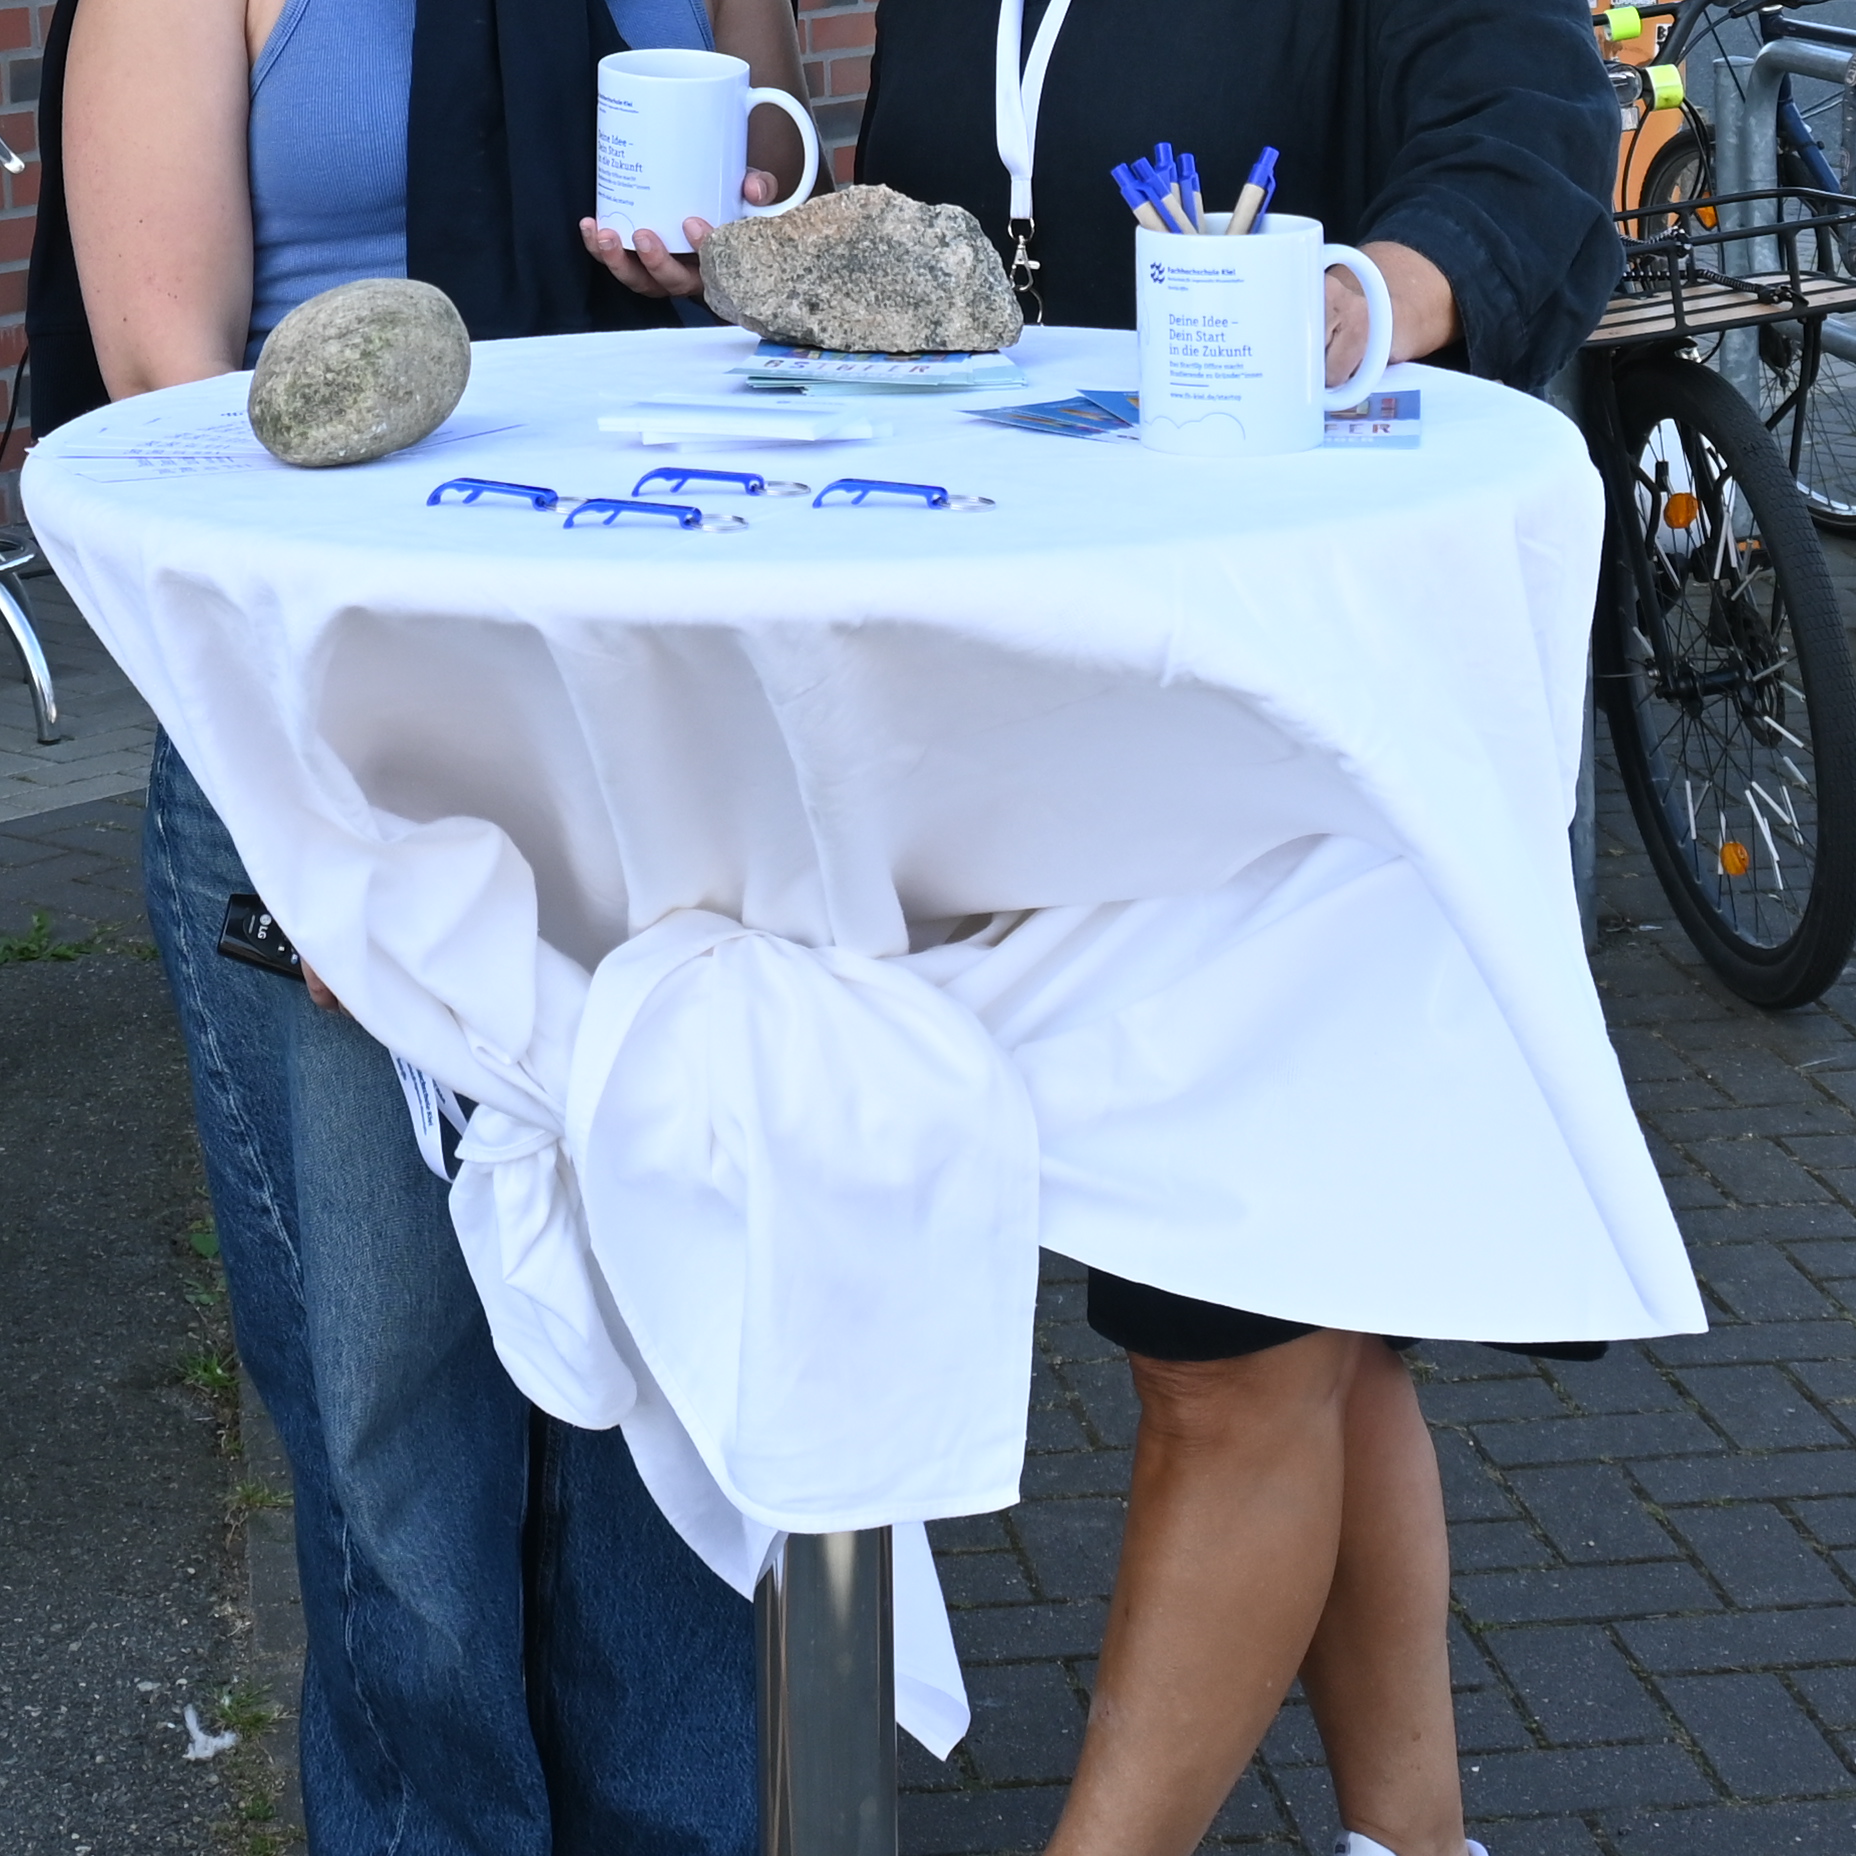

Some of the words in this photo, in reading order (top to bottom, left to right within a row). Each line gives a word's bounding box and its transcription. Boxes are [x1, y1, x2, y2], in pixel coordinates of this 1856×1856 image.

[611, 158, 643, 173] Zukunft
[1169, 313, 1199, 327] Deine
[1202, 315, 1228, 328] Idee
[1169, 328, 1193, 342] Dein
[1195, 330, 1226, 343] Start
[1169, 343, 1179, 355] in
[1182, 344, 1199, 357] die
[1202, 344, 1252, 357] Zukunft
